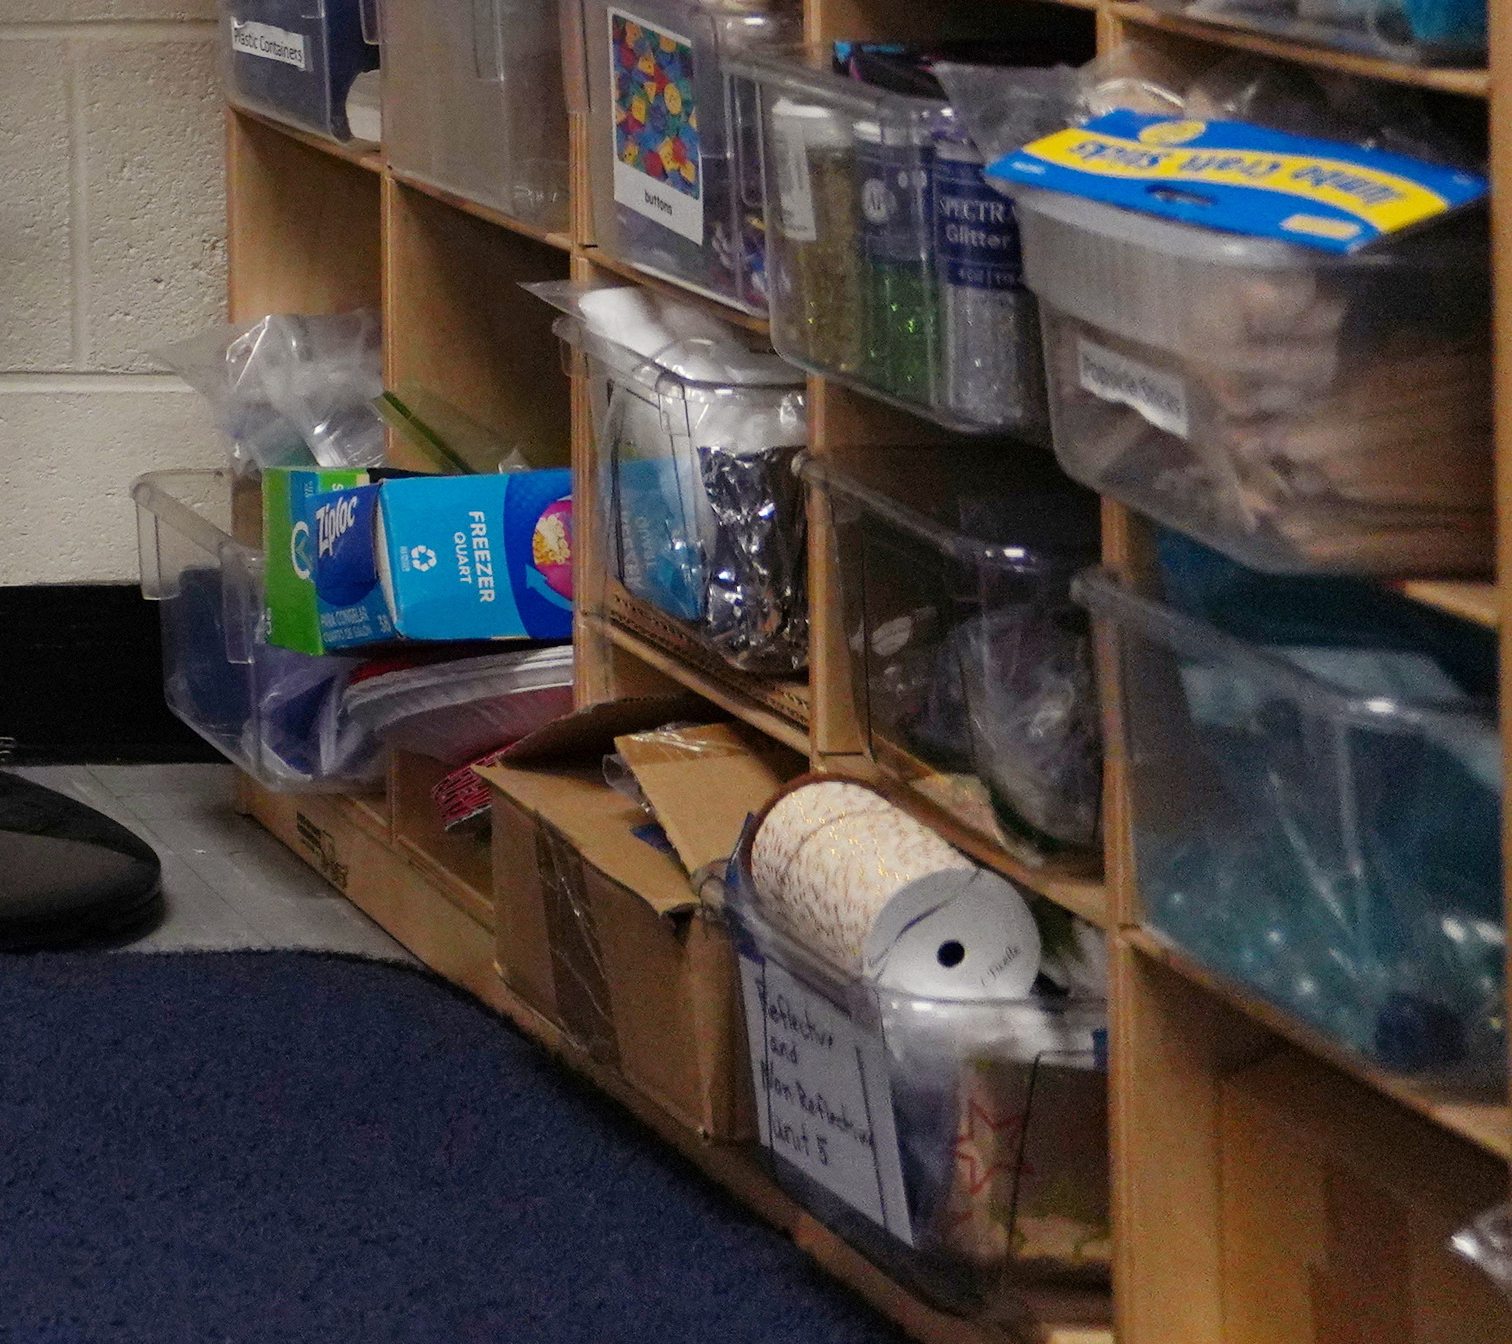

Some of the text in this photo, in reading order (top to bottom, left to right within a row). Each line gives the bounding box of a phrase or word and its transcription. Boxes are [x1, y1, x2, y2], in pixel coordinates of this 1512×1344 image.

[315, 495, 359, 559] Ziploc
[453, 530, 472, 585] QUART
[468, 510, 496, 604] FREEZER
